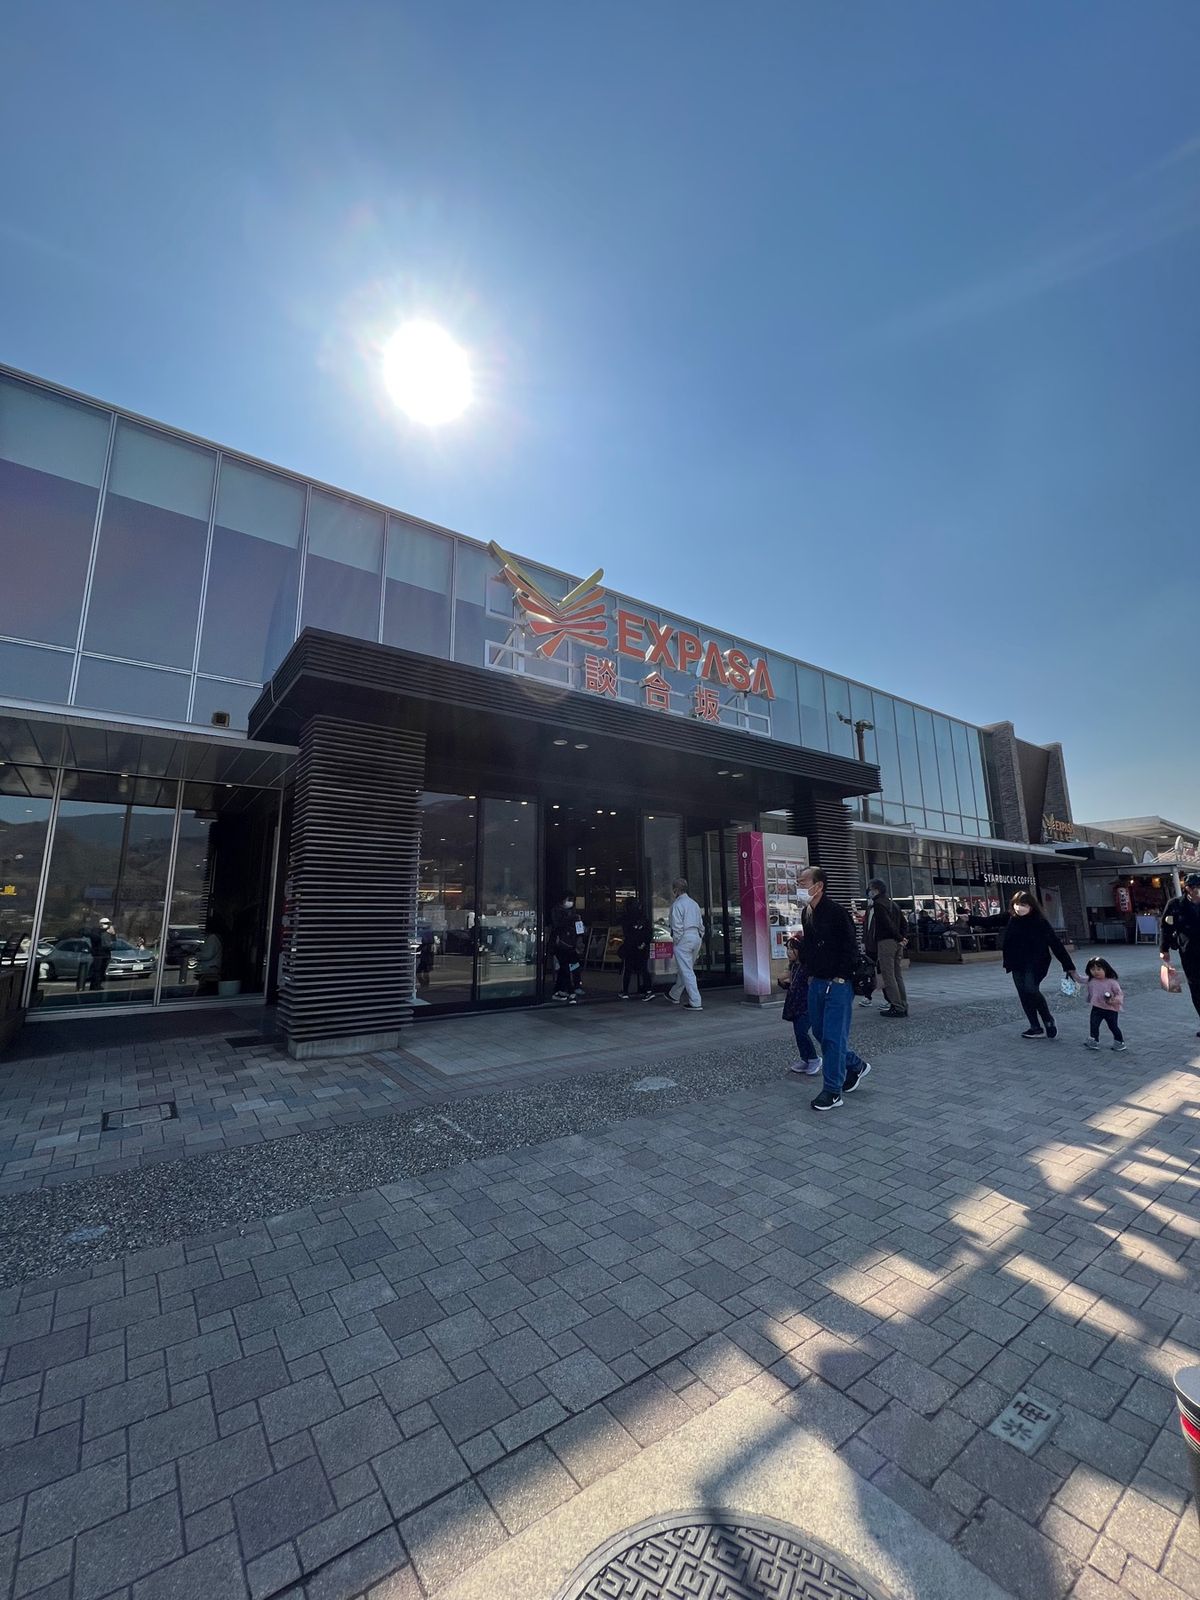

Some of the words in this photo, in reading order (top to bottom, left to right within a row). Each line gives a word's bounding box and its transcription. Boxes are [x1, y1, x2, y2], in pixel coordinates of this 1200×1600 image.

[584, 653, 721, 725] 談合坂
[617, 608, 777, 701] EXPASA
[983, 873, 1017, 885] STARBUCKS
[1017, 876, 1037, 886] COFFEE
